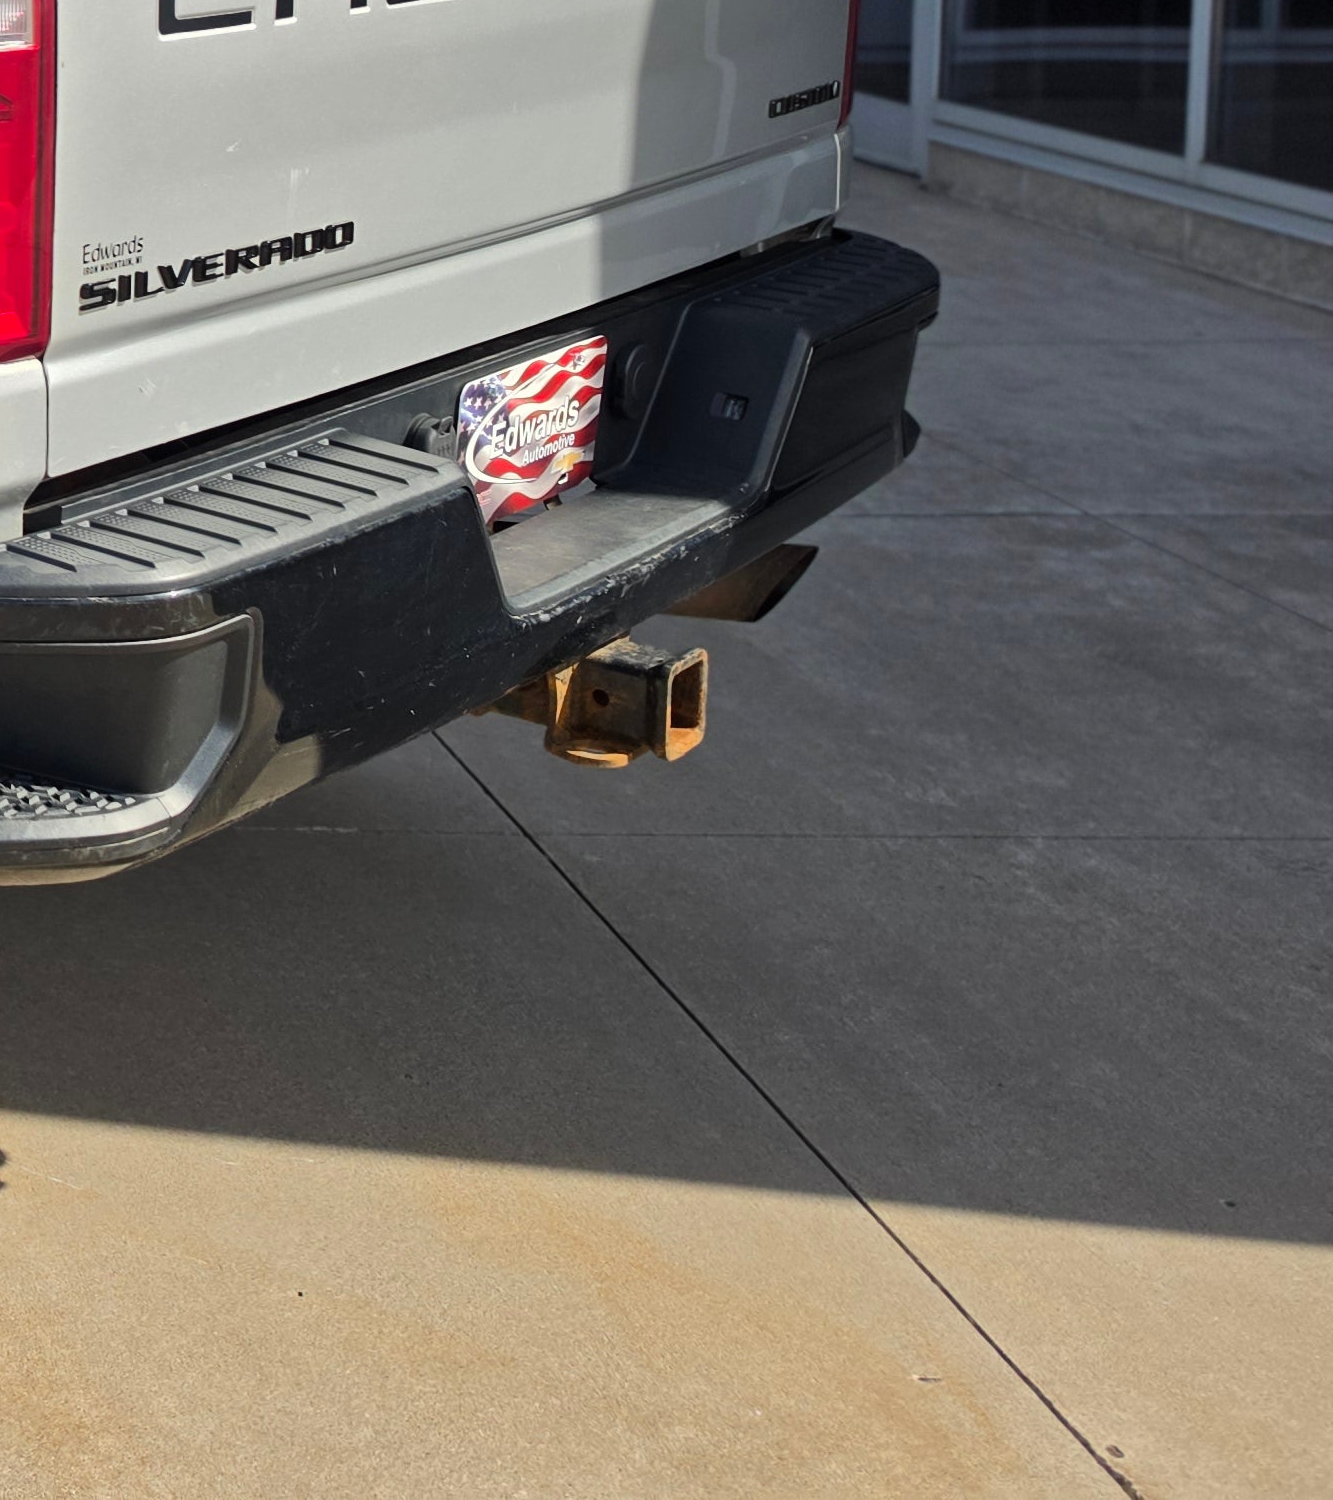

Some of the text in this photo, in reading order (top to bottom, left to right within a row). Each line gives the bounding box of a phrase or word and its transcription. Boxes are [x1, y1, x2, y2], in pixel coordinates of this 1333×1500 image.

[79, 221, 355, 312] SILVERADO
[82, 235, 144, 265] Edwards
[490, 396, 580, 459] Edwards
[522, 433, 575, 465] Automotive
